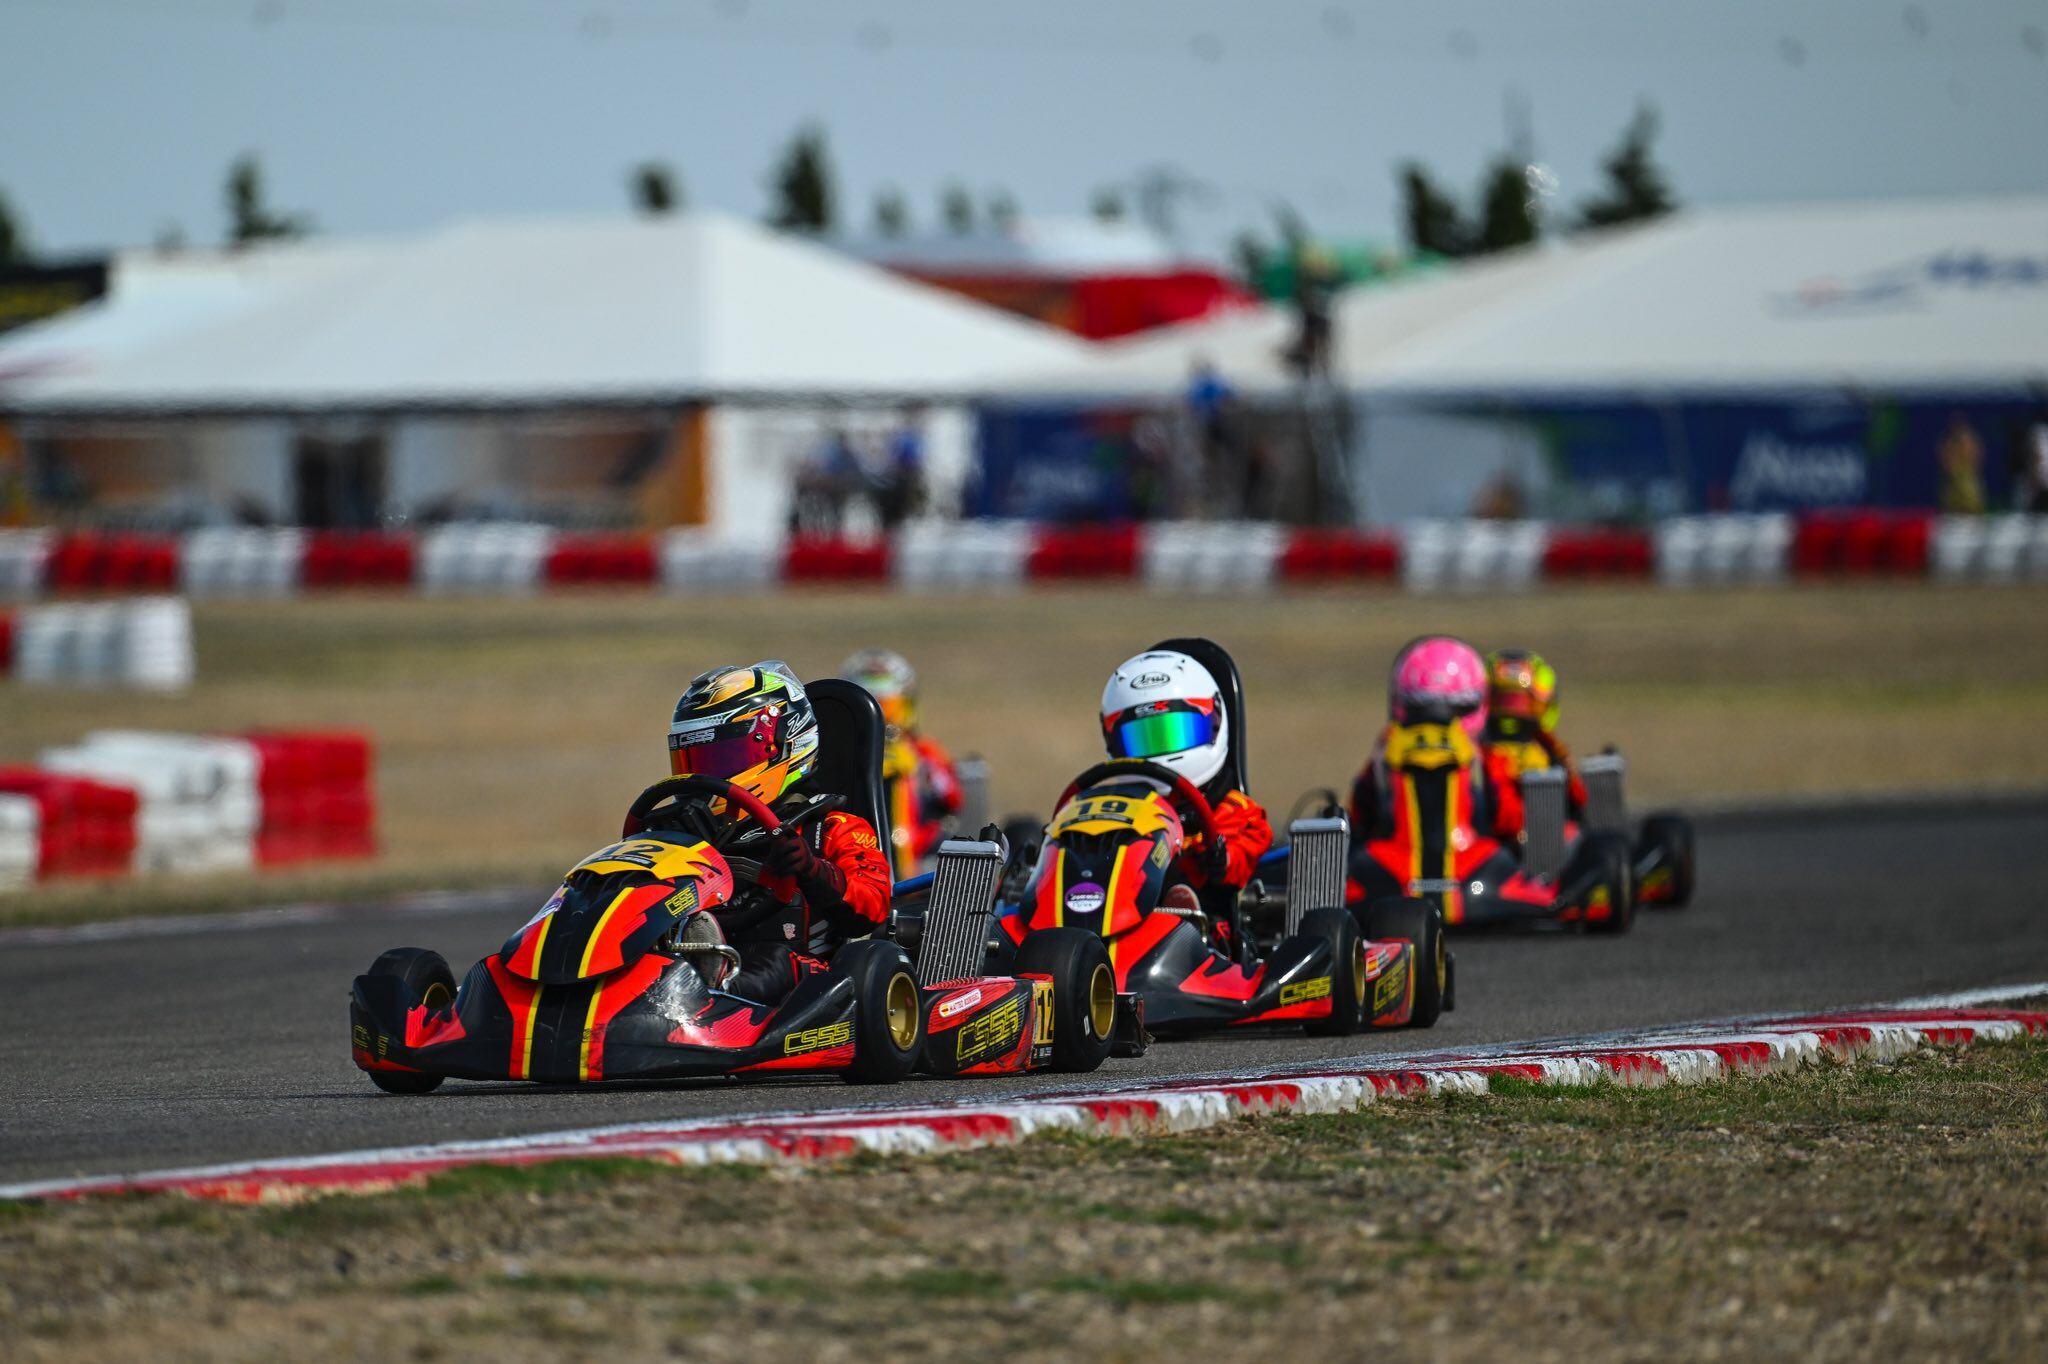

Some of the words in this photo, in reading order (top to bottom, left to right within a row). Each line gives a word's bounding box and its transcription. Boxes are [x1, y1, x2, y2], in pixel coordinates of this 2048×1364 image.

[1076, 800, 1129, 815] 19
[601, 843, 665, 860] 12
[956, 998, 1019, 1061] CS55
[1036, 988, 1054, 1041] 12
[783, 1021, 850, 1054] CS55
